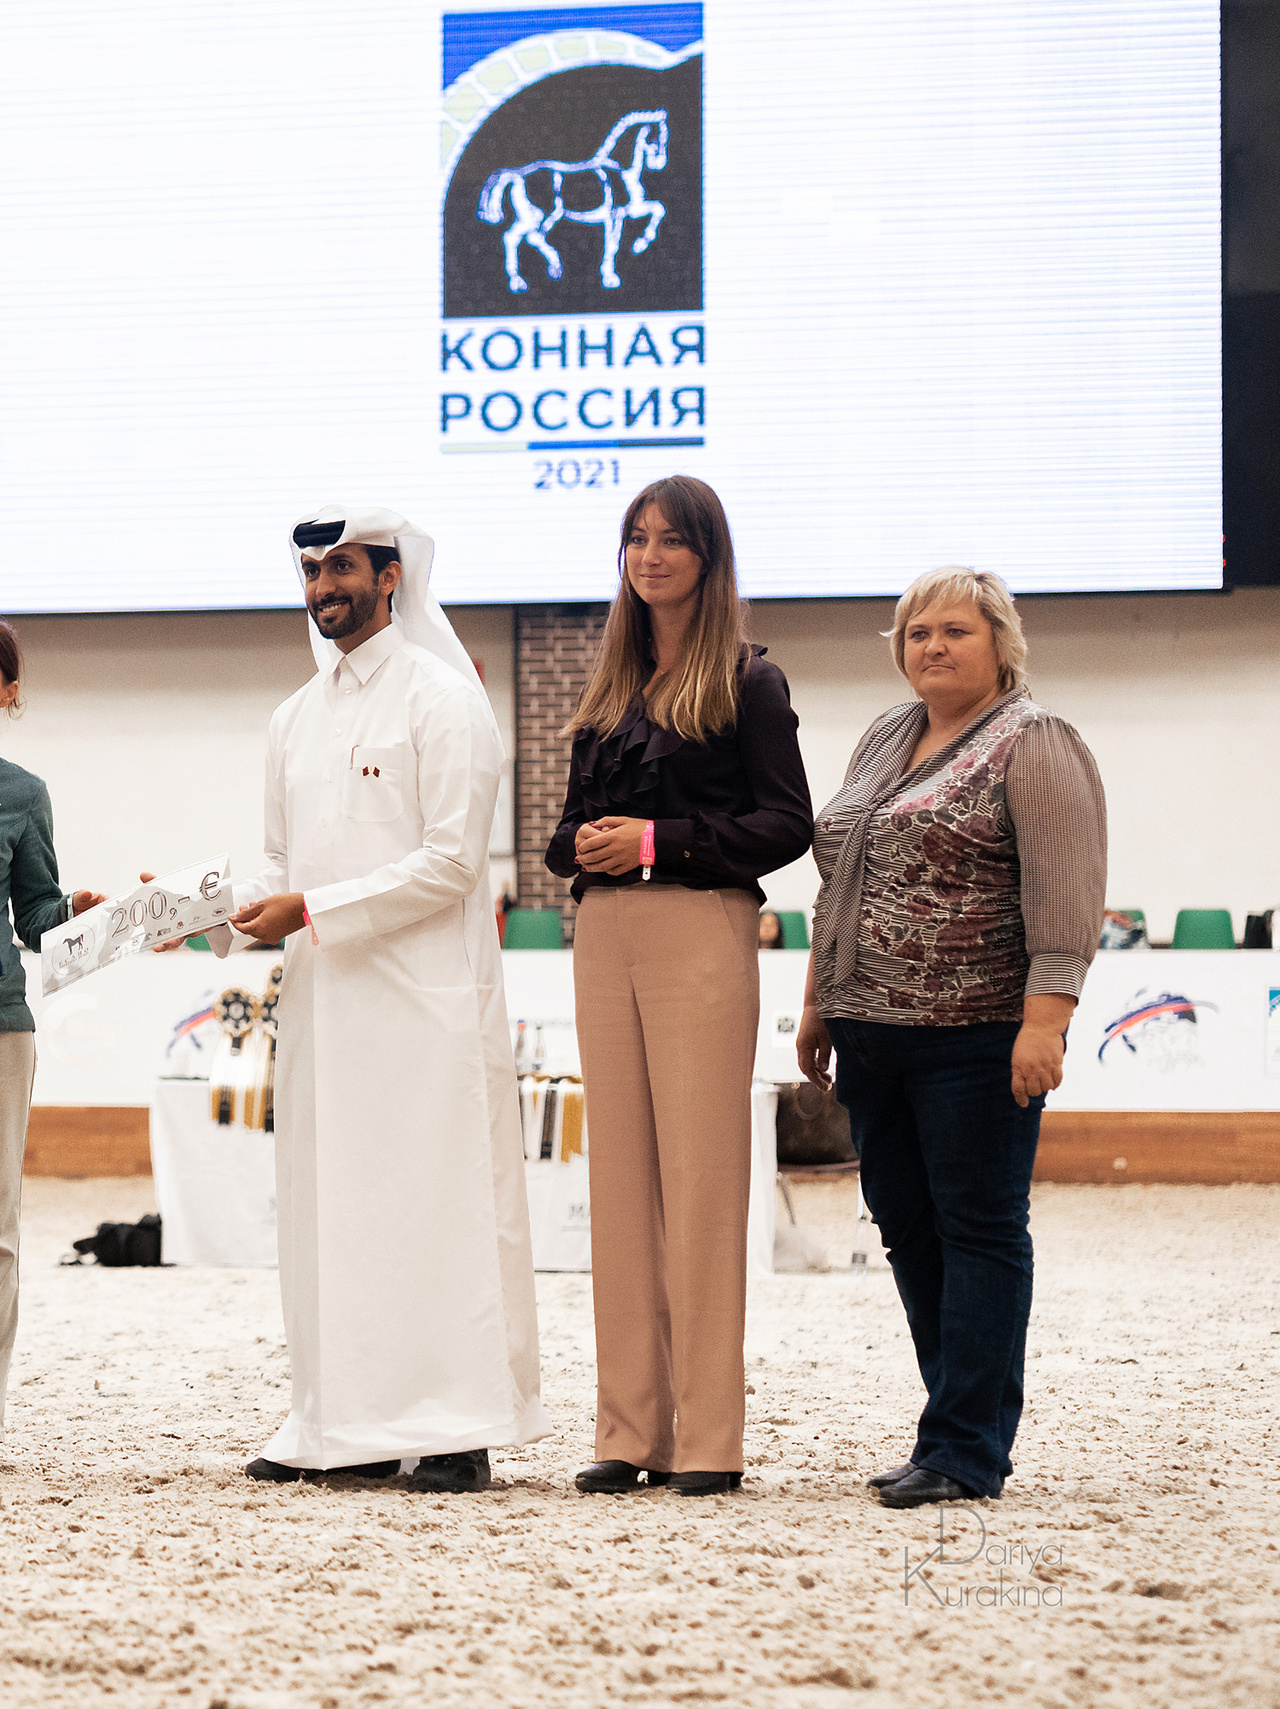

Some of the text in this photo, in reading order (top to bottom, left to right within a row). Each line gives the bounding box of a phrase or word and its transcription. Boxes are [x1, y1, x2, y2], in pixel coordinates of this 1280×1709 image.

[440, 323, 705, 372] КОННАЯ
[440, 386, 705, 433] РОССИЯ
[533, 458, 620, 489] 2021
